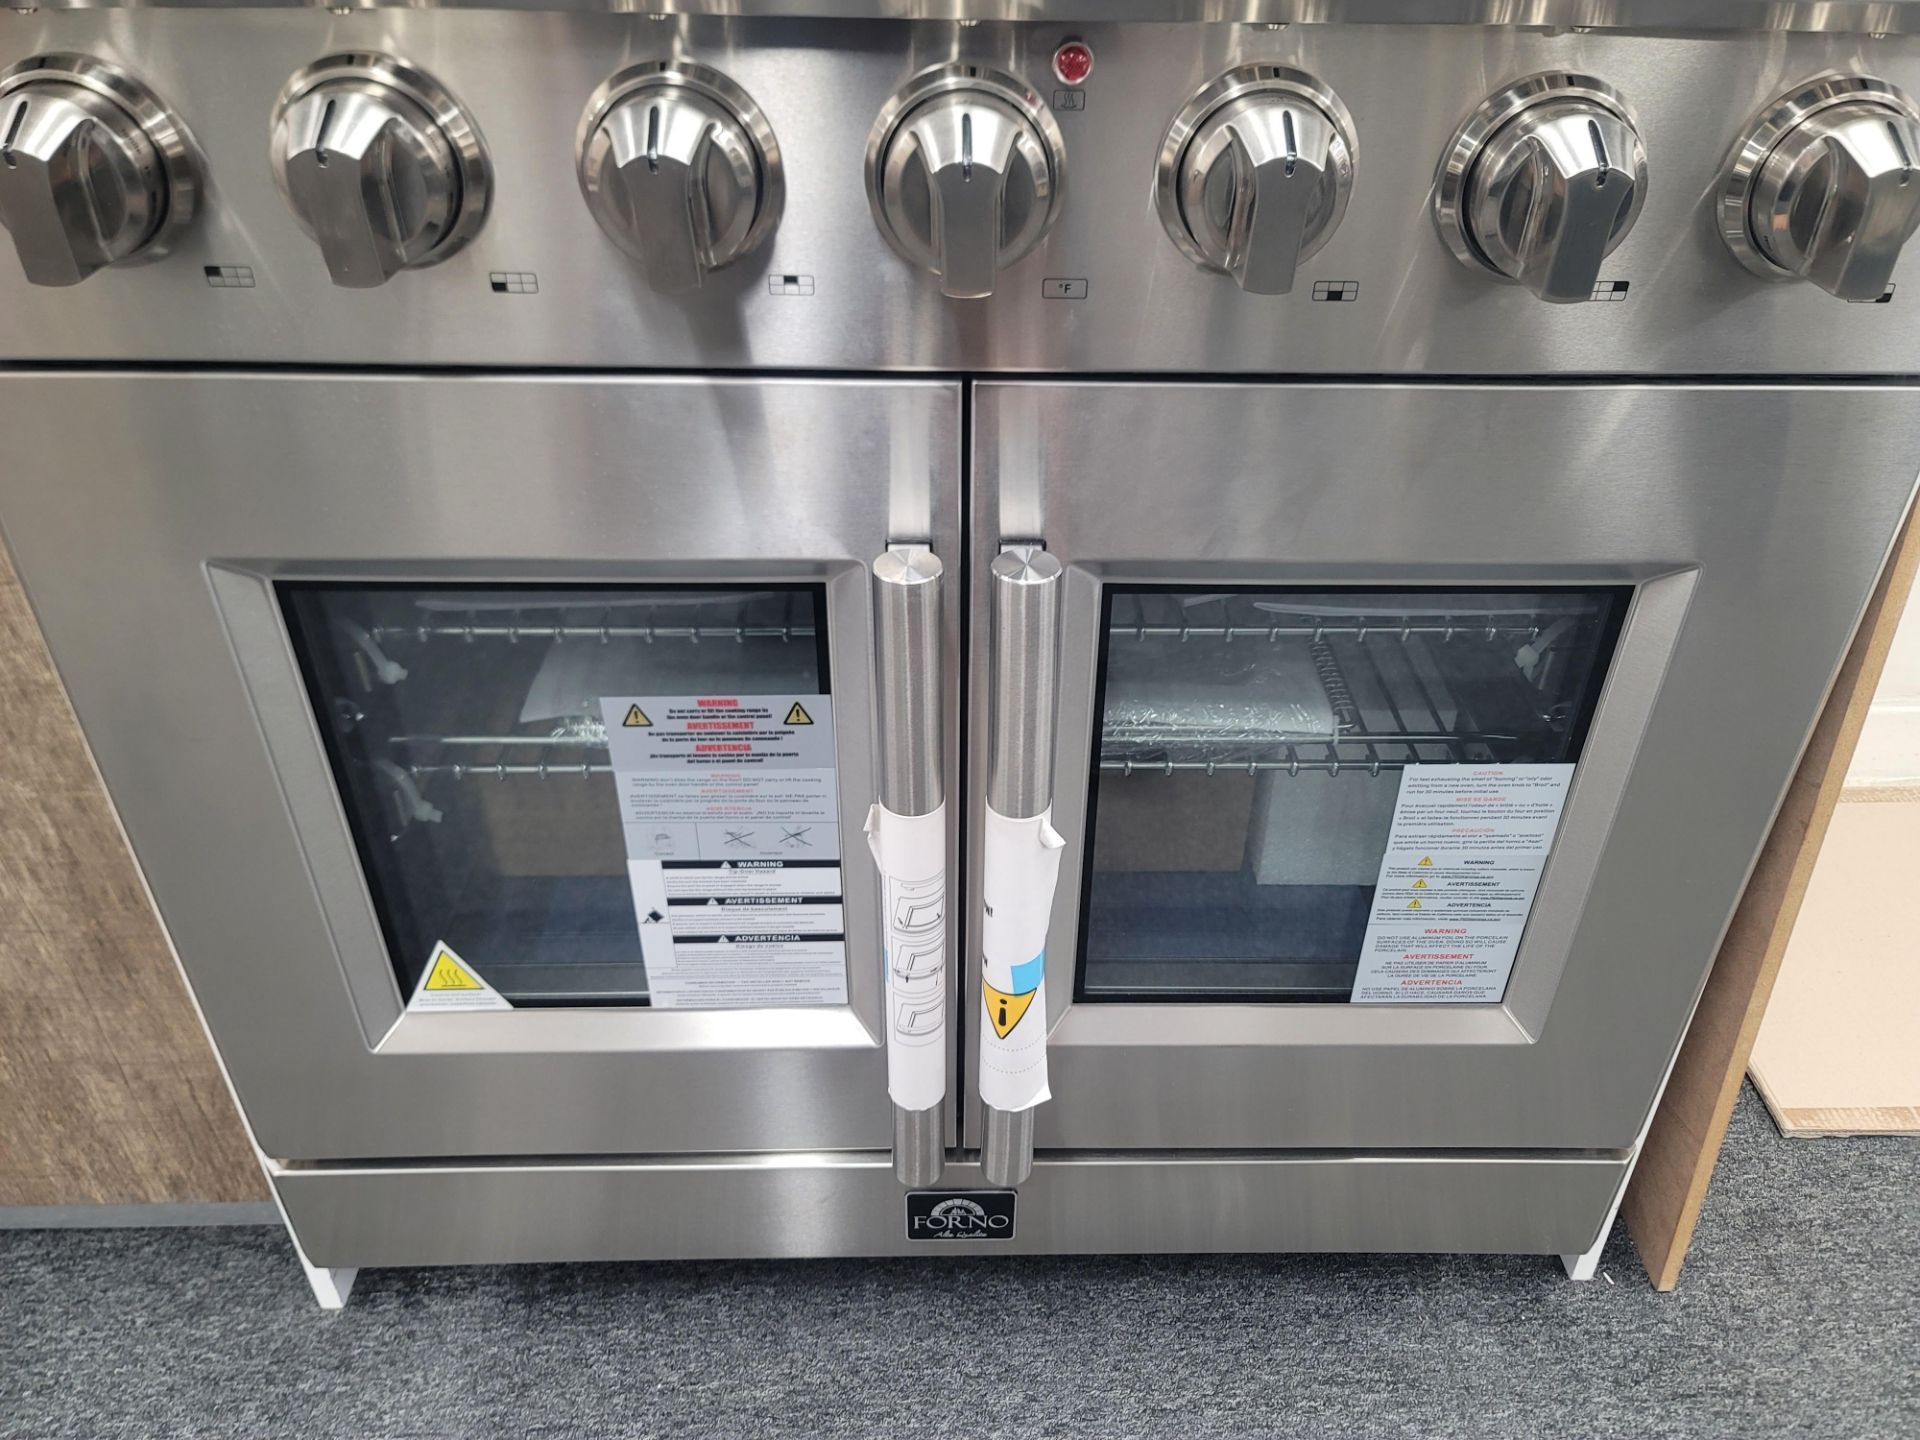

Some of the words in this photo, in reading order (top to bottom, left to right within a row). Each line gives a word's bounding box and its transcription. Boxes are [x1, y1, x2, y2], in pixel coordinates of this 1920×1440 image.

[697, 699, 738, 707] WARNING
[687, 722, 753, 730] AVERTISSEMENT
[696, 744, 752, 752] ADVERTENCIA
[725, 897, 803, 905] AVERTISSEMENT
[914, 1215, 1009, 1229] FORNO
